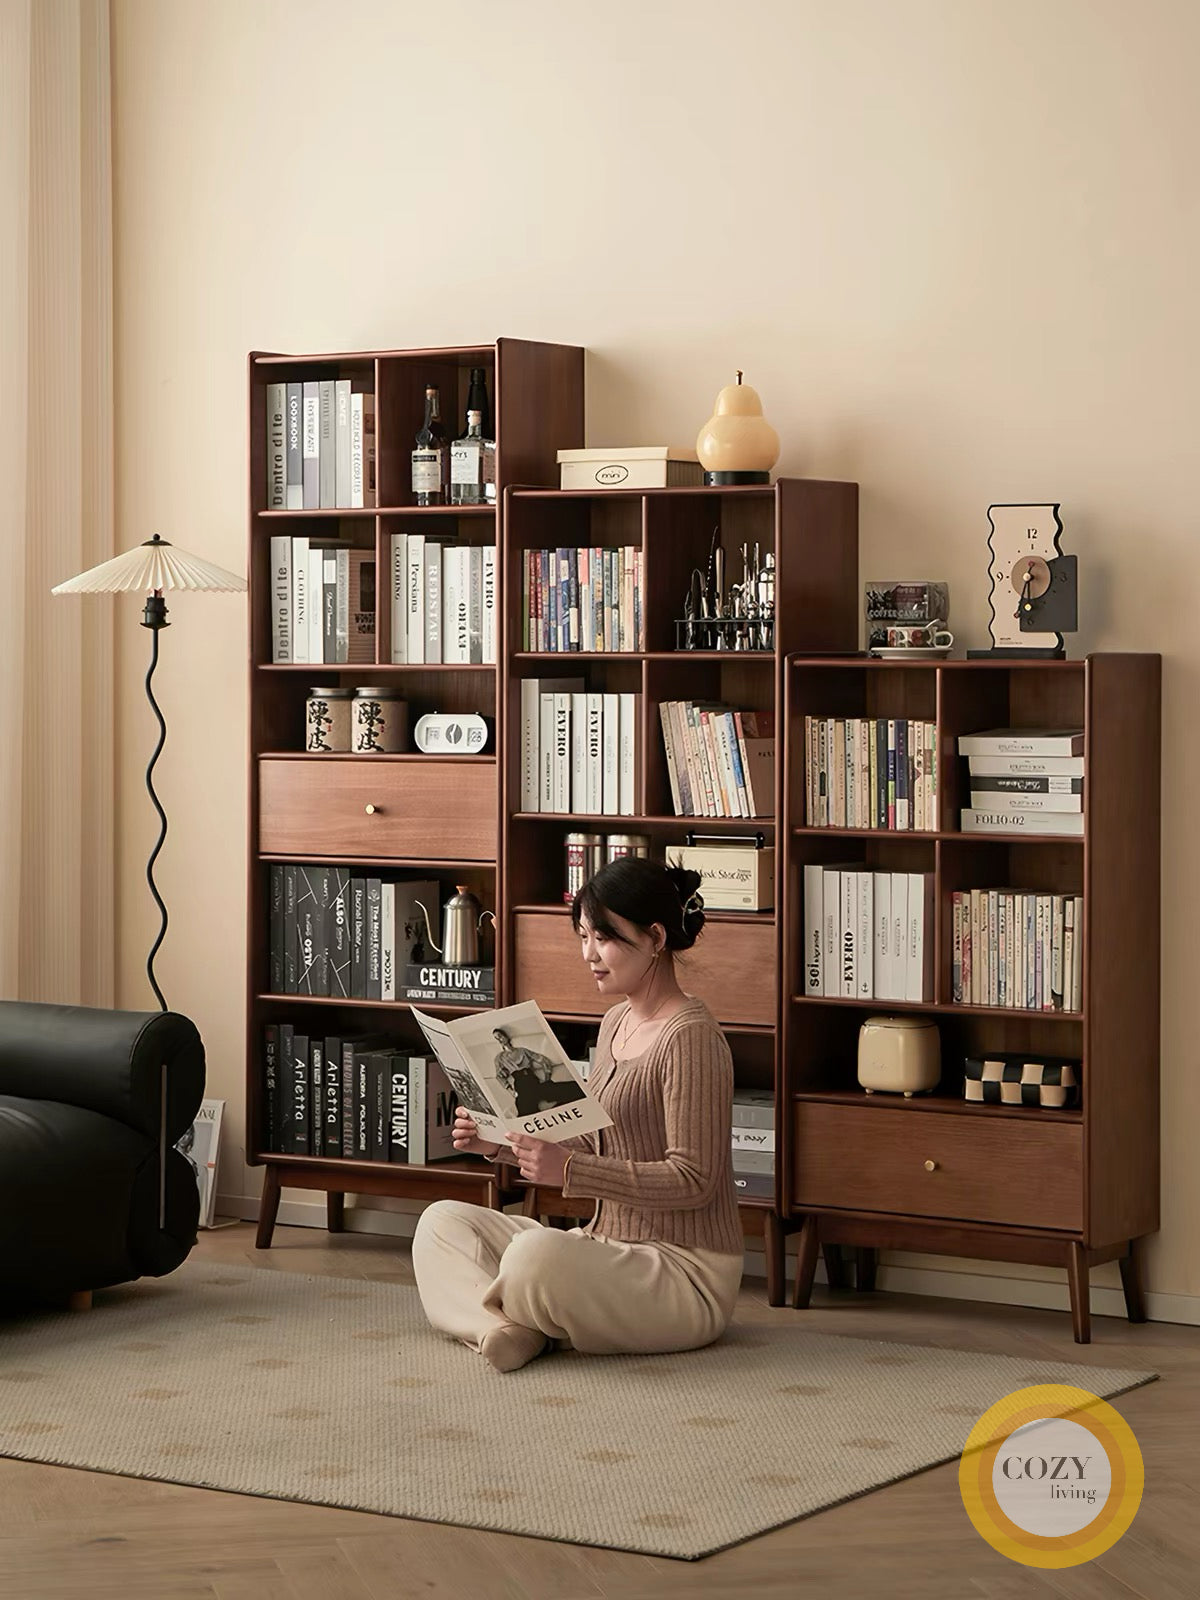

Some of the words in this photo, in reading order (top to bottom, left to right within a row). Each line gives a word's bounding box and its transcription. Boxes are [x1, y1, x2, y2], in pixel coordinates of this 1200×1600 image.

[272, 413, 283, 427] te
[272, 432, 283, 447] di
[272, 453, 283, 506] Dentro
[1027, 528, 1038, 539] 12
[277, 566, 288, 581] te
[277, 585, 288, 601] di
[411, 563, 419, 613] Persiana
[485, 562, 493, 609] EVERO
[428, 564, 439, 641] REDSTAR
[458, 602, 467, 649] EVERO
[277, 608, 288, 660] Dentro
[557, 710, 566, 757] EVERO
[590, 710, 598, 757] EVERO
[420, 967, 481, 989] CENTURY
[843, 931, 853, 982] EVERO
[294, 1058, 306, 1121] Arletta
[327, 1060, 339, 1124] Arletta
[391, 1073, 407, 1148] CENTURY
[523, 1107, 583, 1134] CÉLINE
